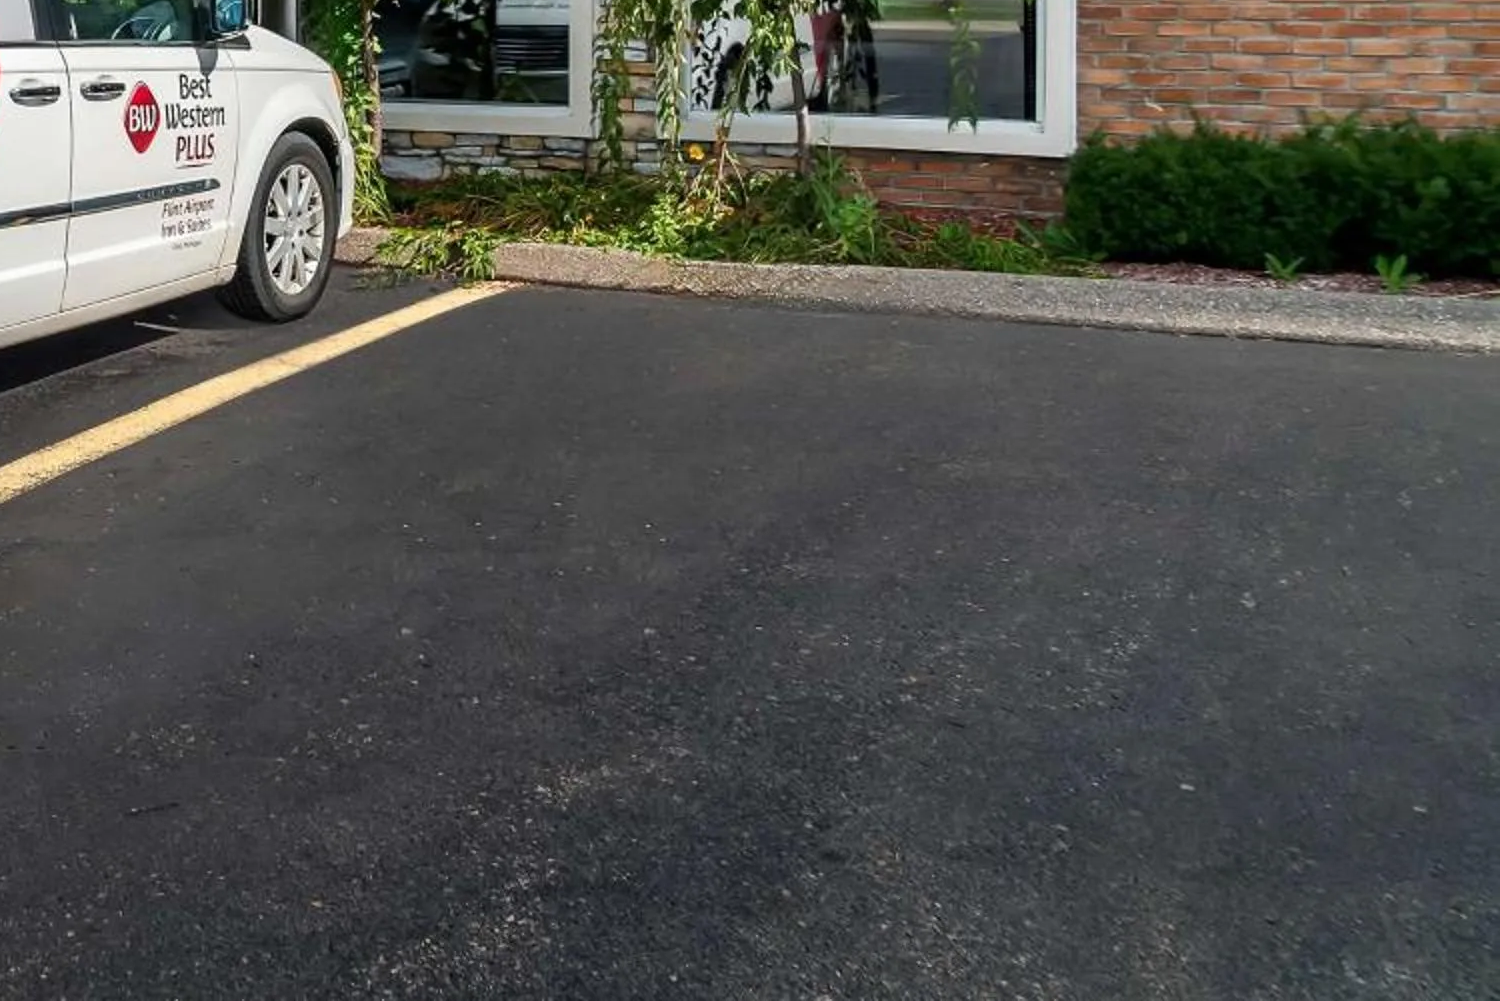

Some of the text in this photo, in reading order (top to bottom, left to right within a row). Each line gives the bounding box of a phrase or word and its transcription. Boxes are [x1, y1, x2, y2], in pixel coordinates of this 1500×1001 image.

[179, 74, 212, 99] Best
[128, 105, 157, 133] BW
[165, 104, 225, 129] Western
[175, 133, 215, 161] PLUS
[184, 199, 215, 216] Airport
[162, 223, 176, 238] Inn
[187, 218, 212, 233] Suites
